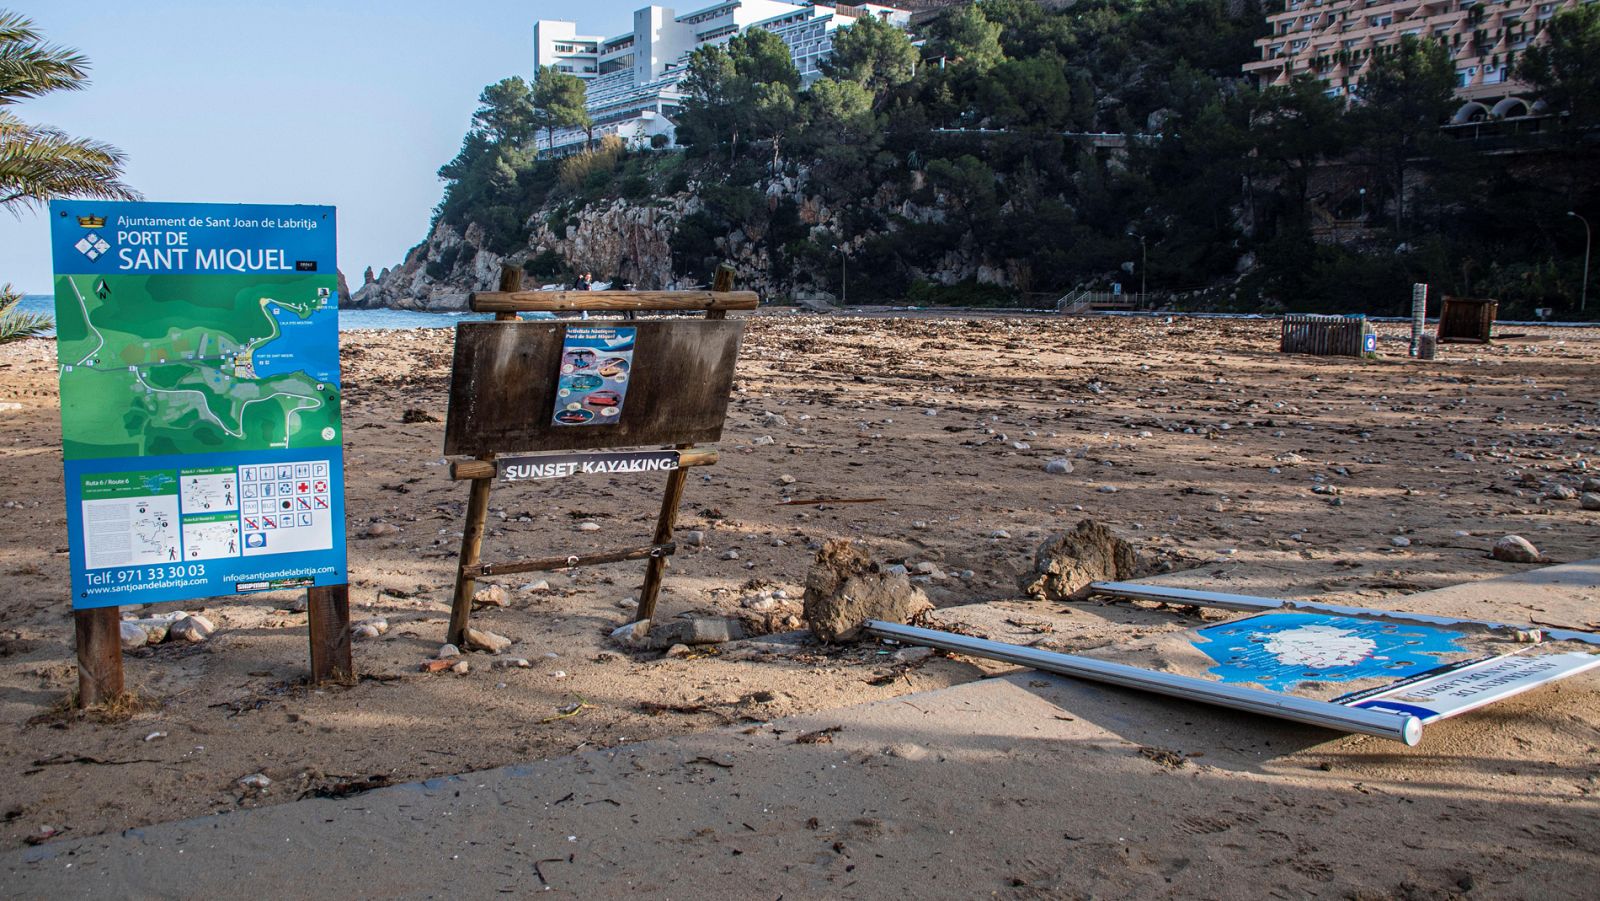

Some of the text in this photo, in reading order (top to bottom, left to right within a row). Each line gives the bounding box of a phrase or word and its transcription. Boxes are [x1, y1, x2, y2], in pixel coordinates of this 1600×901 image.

[117, 215, 317, 231] Ajuntament de Sant Joan de Labritja
[117, 231, 189, 246] PORT DE
[119, 248, 189, 270] SANT
[195, 248, 293, 272] MIQUEL
[505, 457, 672, 478] SUNSET KAYAKING
[85, 564, 205, 585] Telf. 971 33 30 03
[223, 566, 335, 582] info@santjoandelabritja.com
[86, 577, 209, 594] www.santjoandelabritja.com
